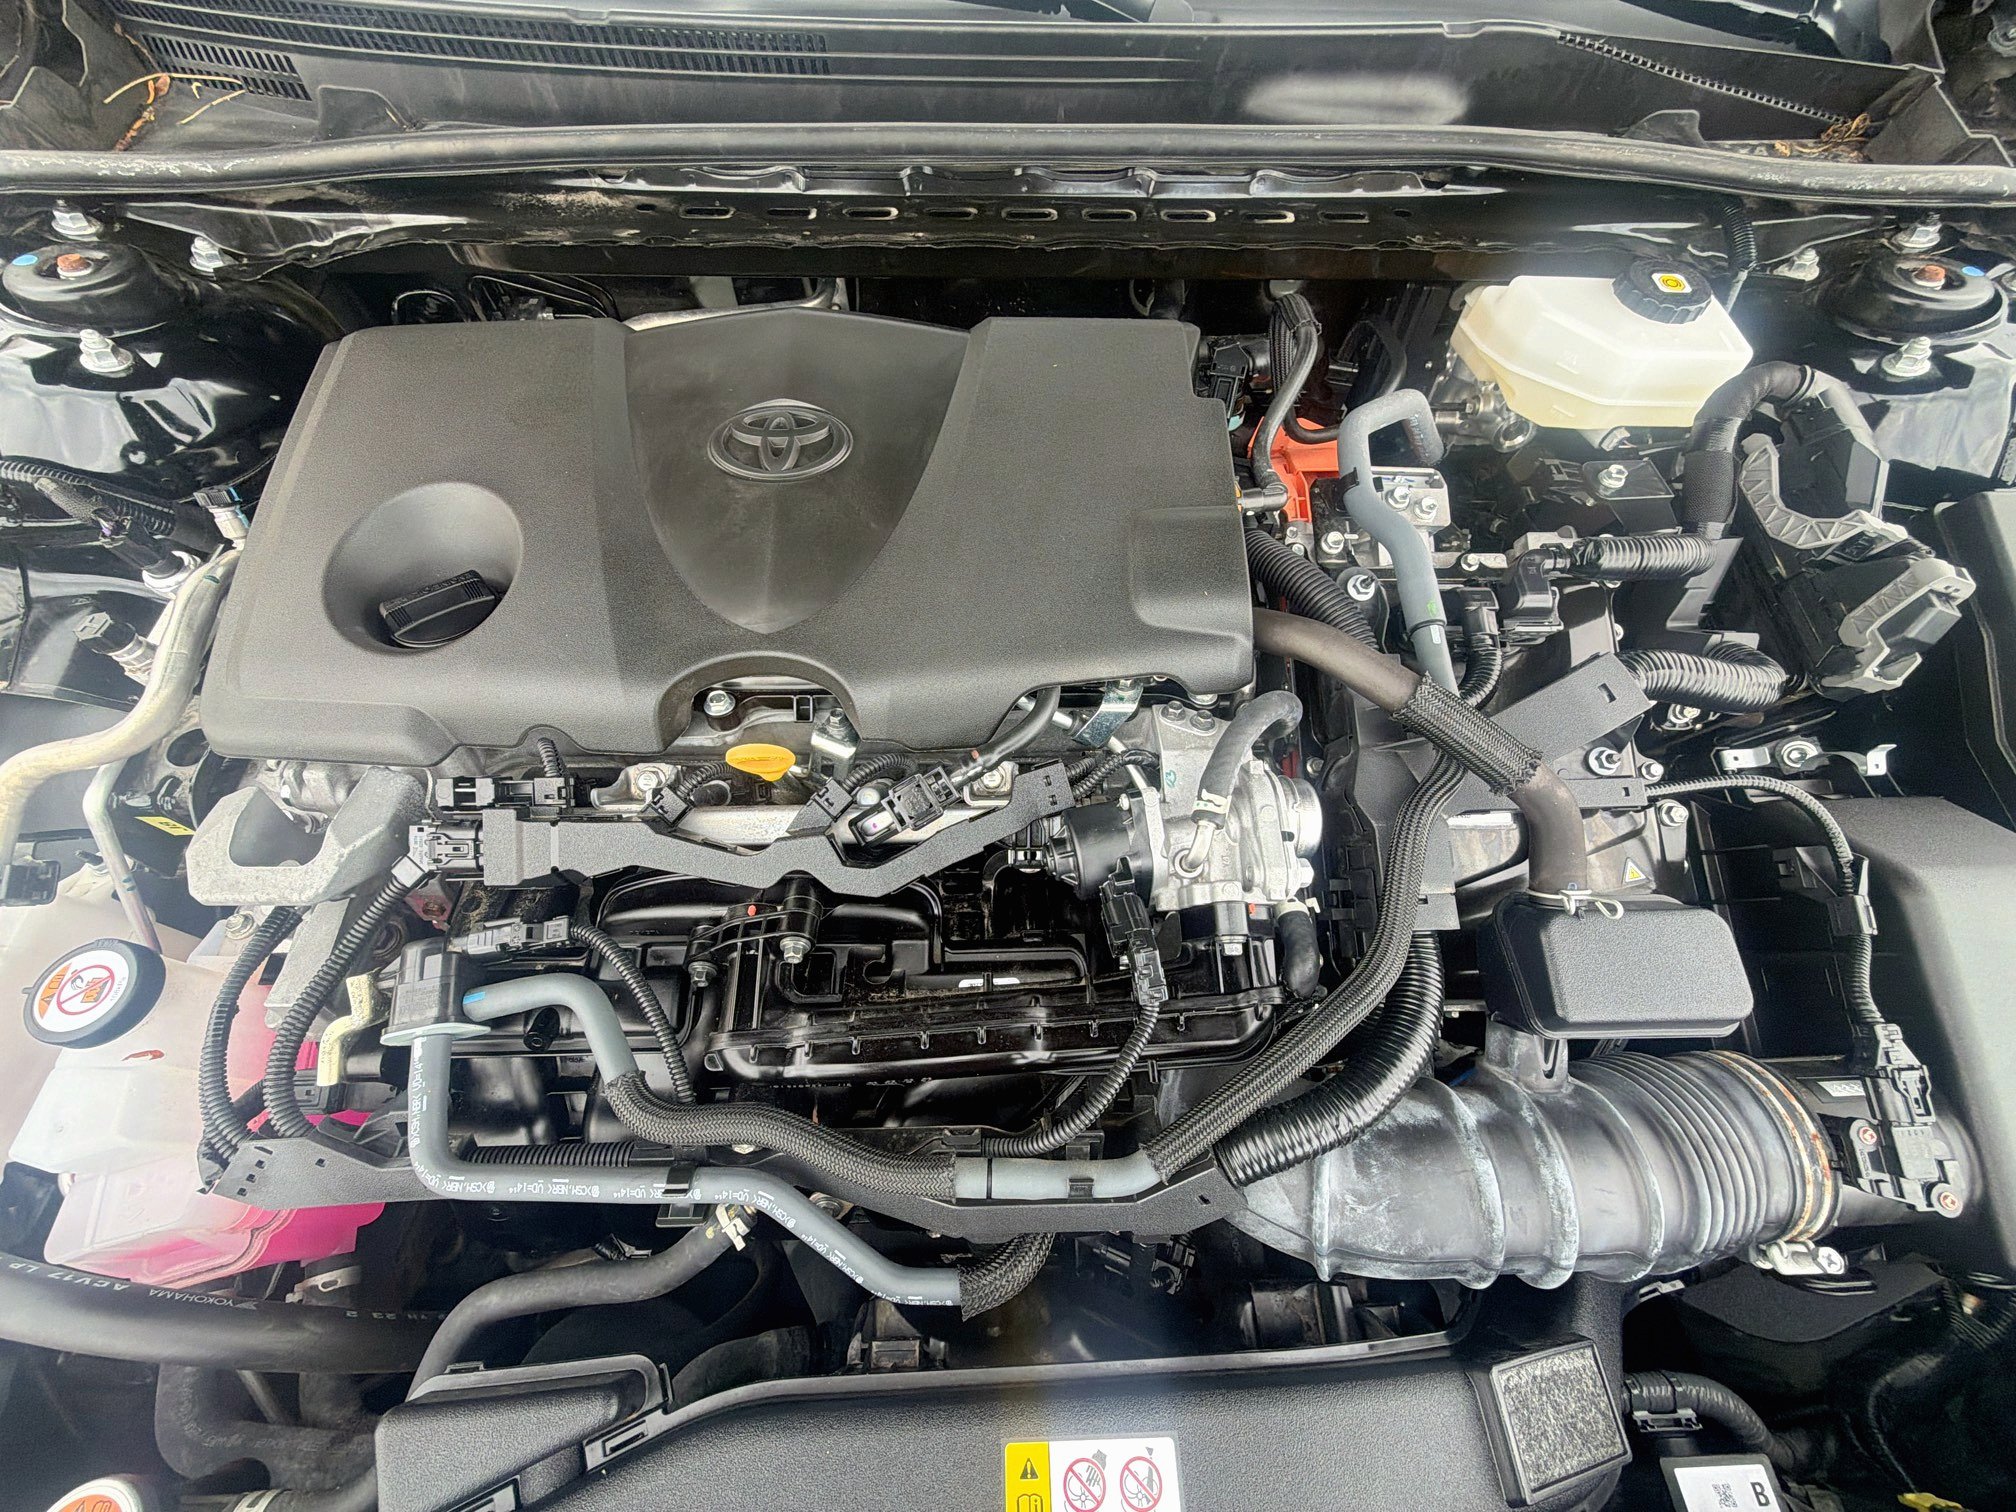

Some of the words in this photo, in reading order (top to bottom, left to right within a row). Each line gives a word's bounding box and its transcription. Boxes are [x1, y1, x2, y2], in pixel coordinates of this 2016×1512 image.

[8, 1260, 41, 1274] LP
[47, 1270, 131, 1292] ACV17
[147, 1287, 234, 1308] YOKOHAMA
[1750, 1481, 1771, 1507] B
